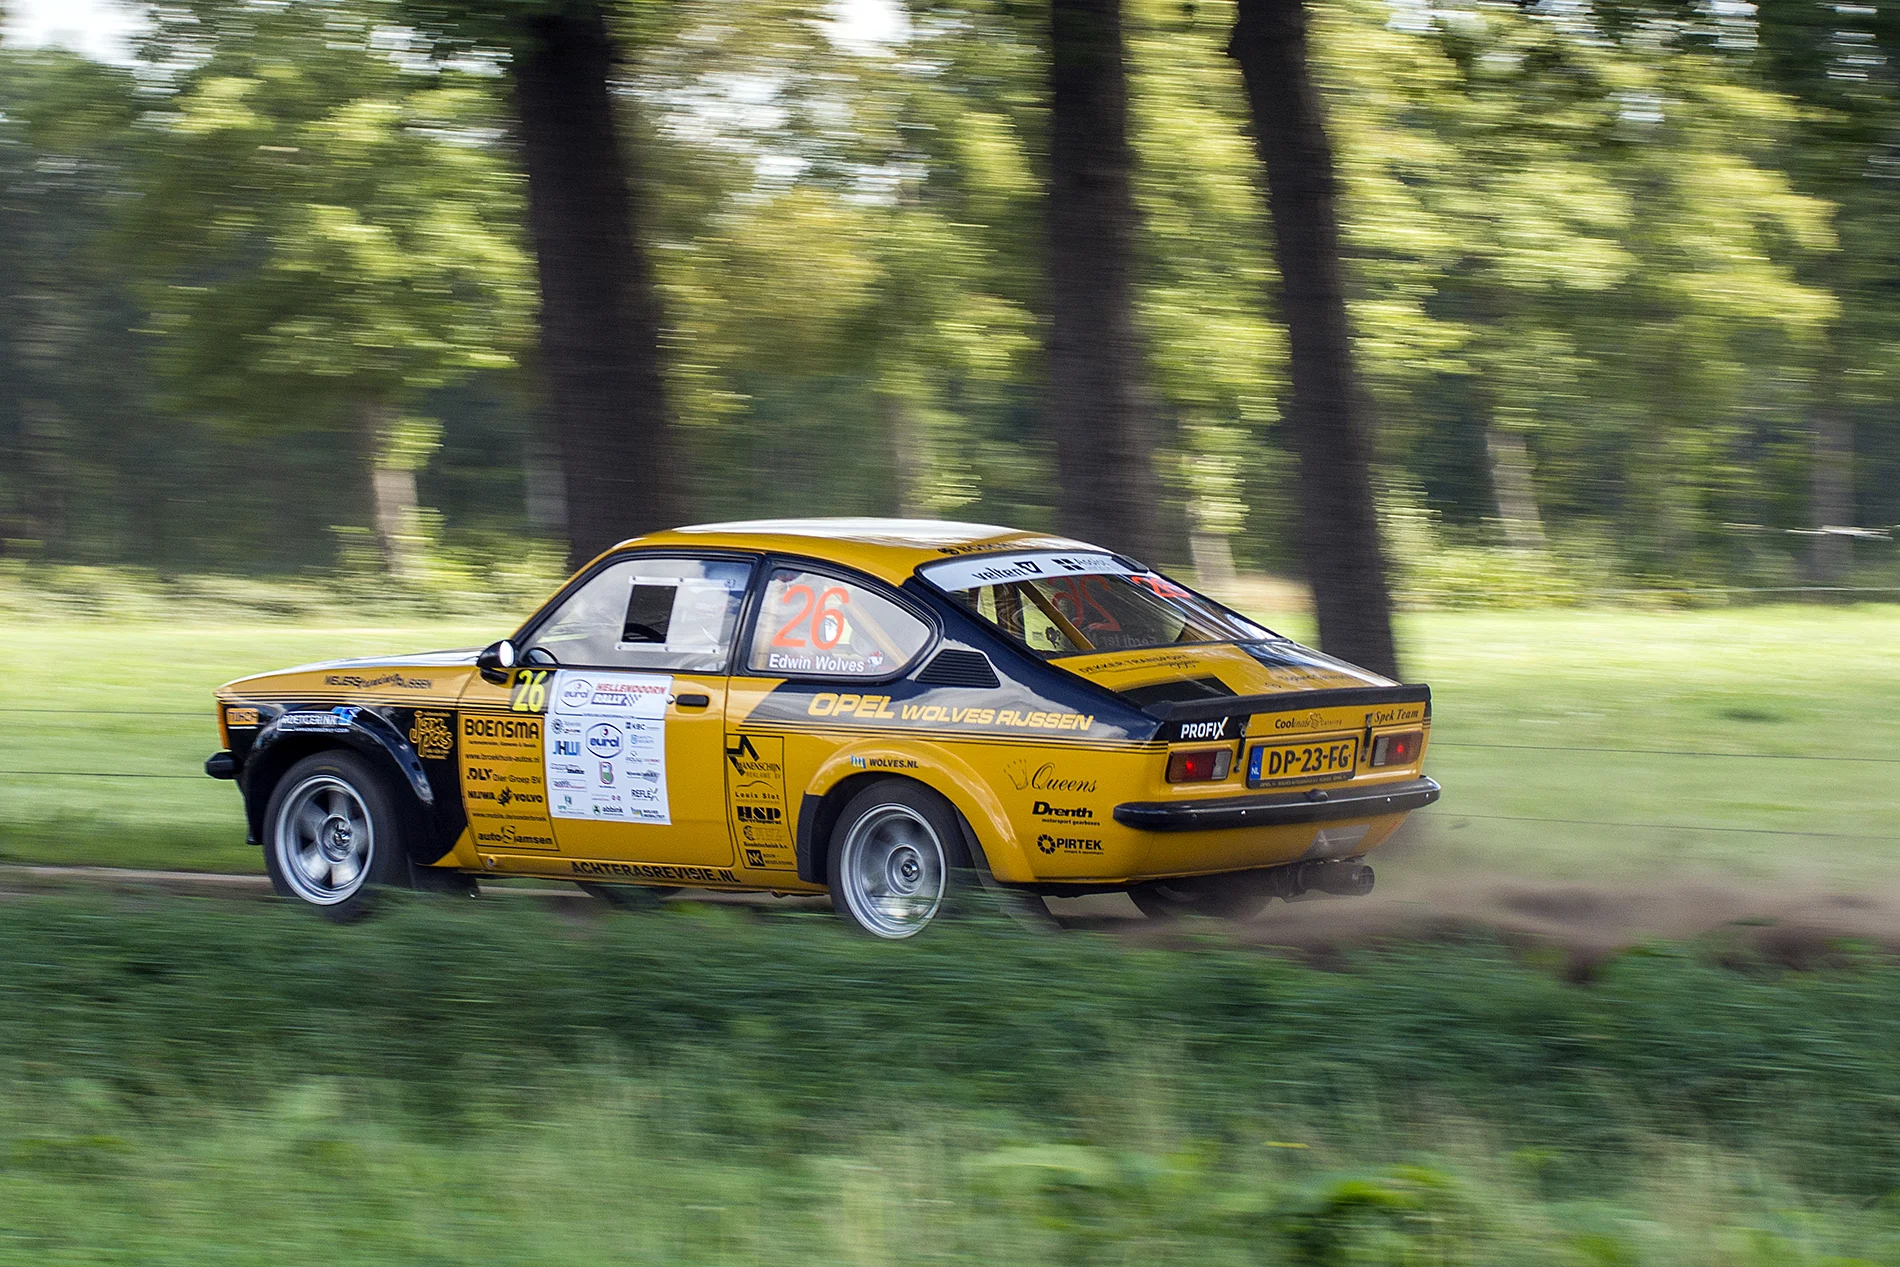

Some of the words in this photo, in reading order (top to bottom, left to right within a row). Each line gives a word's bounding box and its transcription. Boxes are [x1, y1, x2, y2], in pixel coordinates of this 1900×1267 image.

[771, 584, 849, 650] 26
[768, 653, 811, 669] Edwin
[815, 655, 865, 672] Wolves
[512, 670, 546, 712] 26
[564, 689, 589, 699] eurol
[596, 683, 667, 694] HELLENDOORN
[807, 693, 895, 719] OPEL
[900, 704, 995, 724] WOLVES
[996, 709, 1094, 731] RIJSSEN
[1374, 711, 1394, 725] Spek
[1397, 709, 1419, 720] Team
[1180, 716, 1229, 740] PROFIX
[589, 736, 620, 747] eurol
[869, 758, 919, 768] WOLVES.NL
[1268, 744, 1350, 775] DP-23-FG
[1031, 762, 1097, 792] Queens
[1251, 767, 1260, 775] NL
[513, 793, 544, 803] VOLVO
[735, 791, 758, 799] Louis
[736, 806, 781, 820] HSP
[1032, 801, 1093, 818] Drenth
[1042, 818, 1071, 826] motorsport
[1056, 838, 1103, 850] PIRTEK
[571, 861, 740, 882] ACHTERASREVISIE.NL
